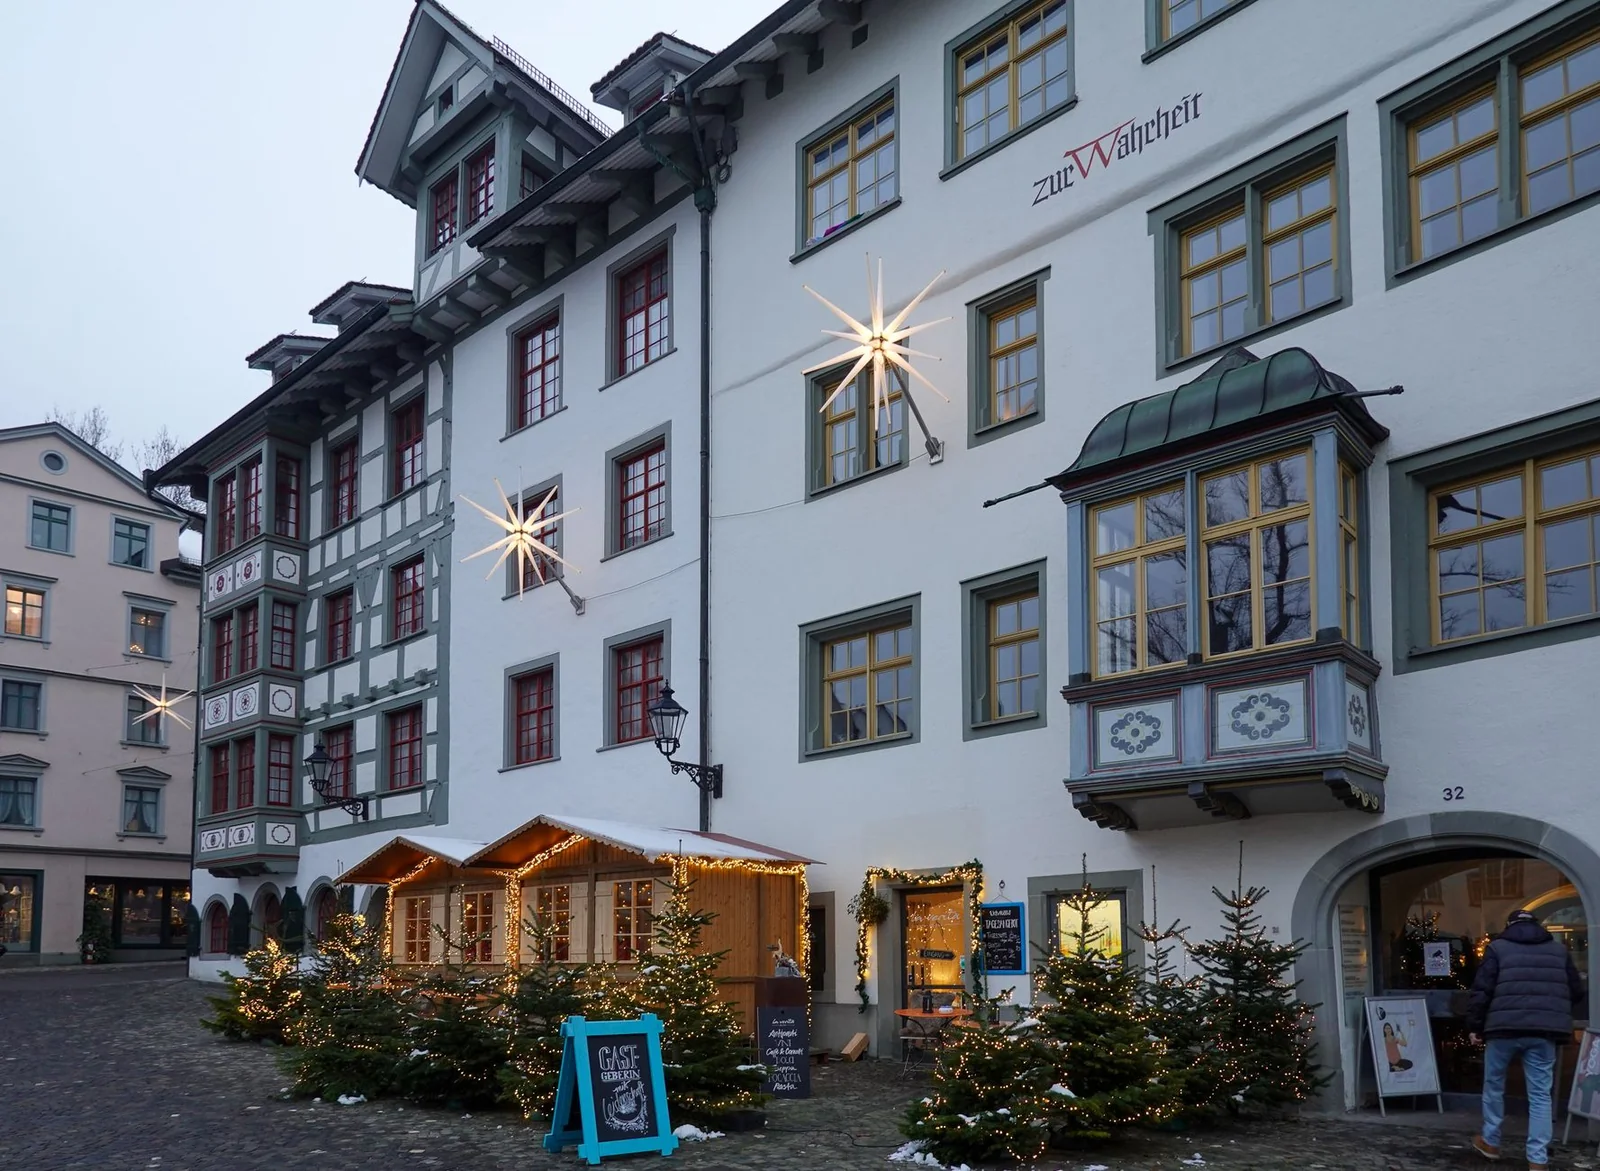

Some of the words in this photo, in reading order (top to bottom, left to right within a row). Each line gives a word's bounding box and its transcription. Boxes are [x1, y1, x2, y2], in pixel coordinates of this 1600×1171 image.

[1031, 163, 1075, 207] zur
[1063, 92, 1203, 180] Wahrheit
[1442, 786, 1465, 801] 32
[600, 1069, 641, 1081] GEBERIN
